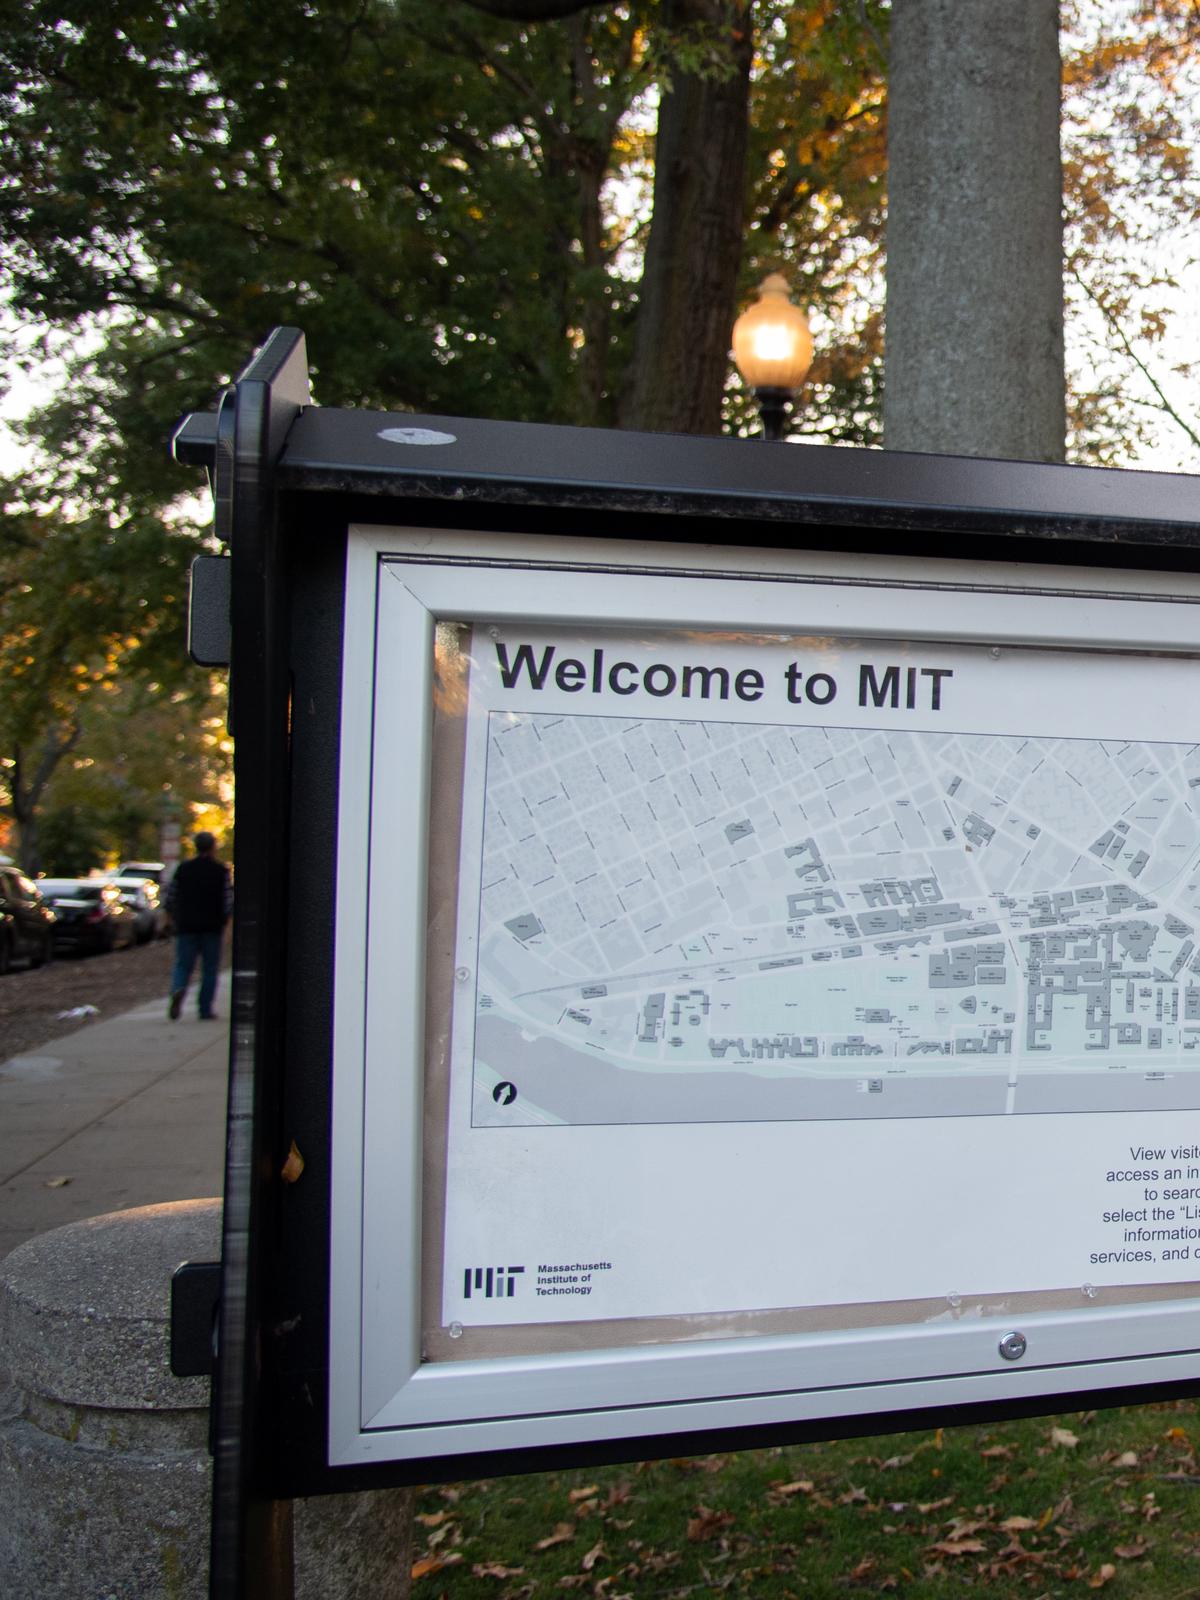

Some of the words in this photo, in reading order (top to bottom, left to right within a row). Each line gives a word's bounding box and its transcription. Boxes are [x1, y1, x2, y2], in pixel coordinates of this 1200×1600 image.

[494, 642, 764, 702] Welcome
[785, 662, 837, 705] to
[858, 664, 954, 711] MIT
[1130, 1146, 1166, 1161] View
[1106, 1169, 1159, 1182] access
[1163, 1168, 1182, 1180] an
[1144, 1187, 1158, 1201] to
[1102, 1208, 1148, 1223] select
[1151, 1207, 1175, 1221] the
[1090, 1248, 1157, 1264] services,
[1161, 1246, 1190, 1261] and
[537, 1261, 612, 1273] Massachusetts
[537, 1271, 578, 1284] Institute
[581, 1270, 592, 1282] of
[535, 1281, 593, 1296] Technology
